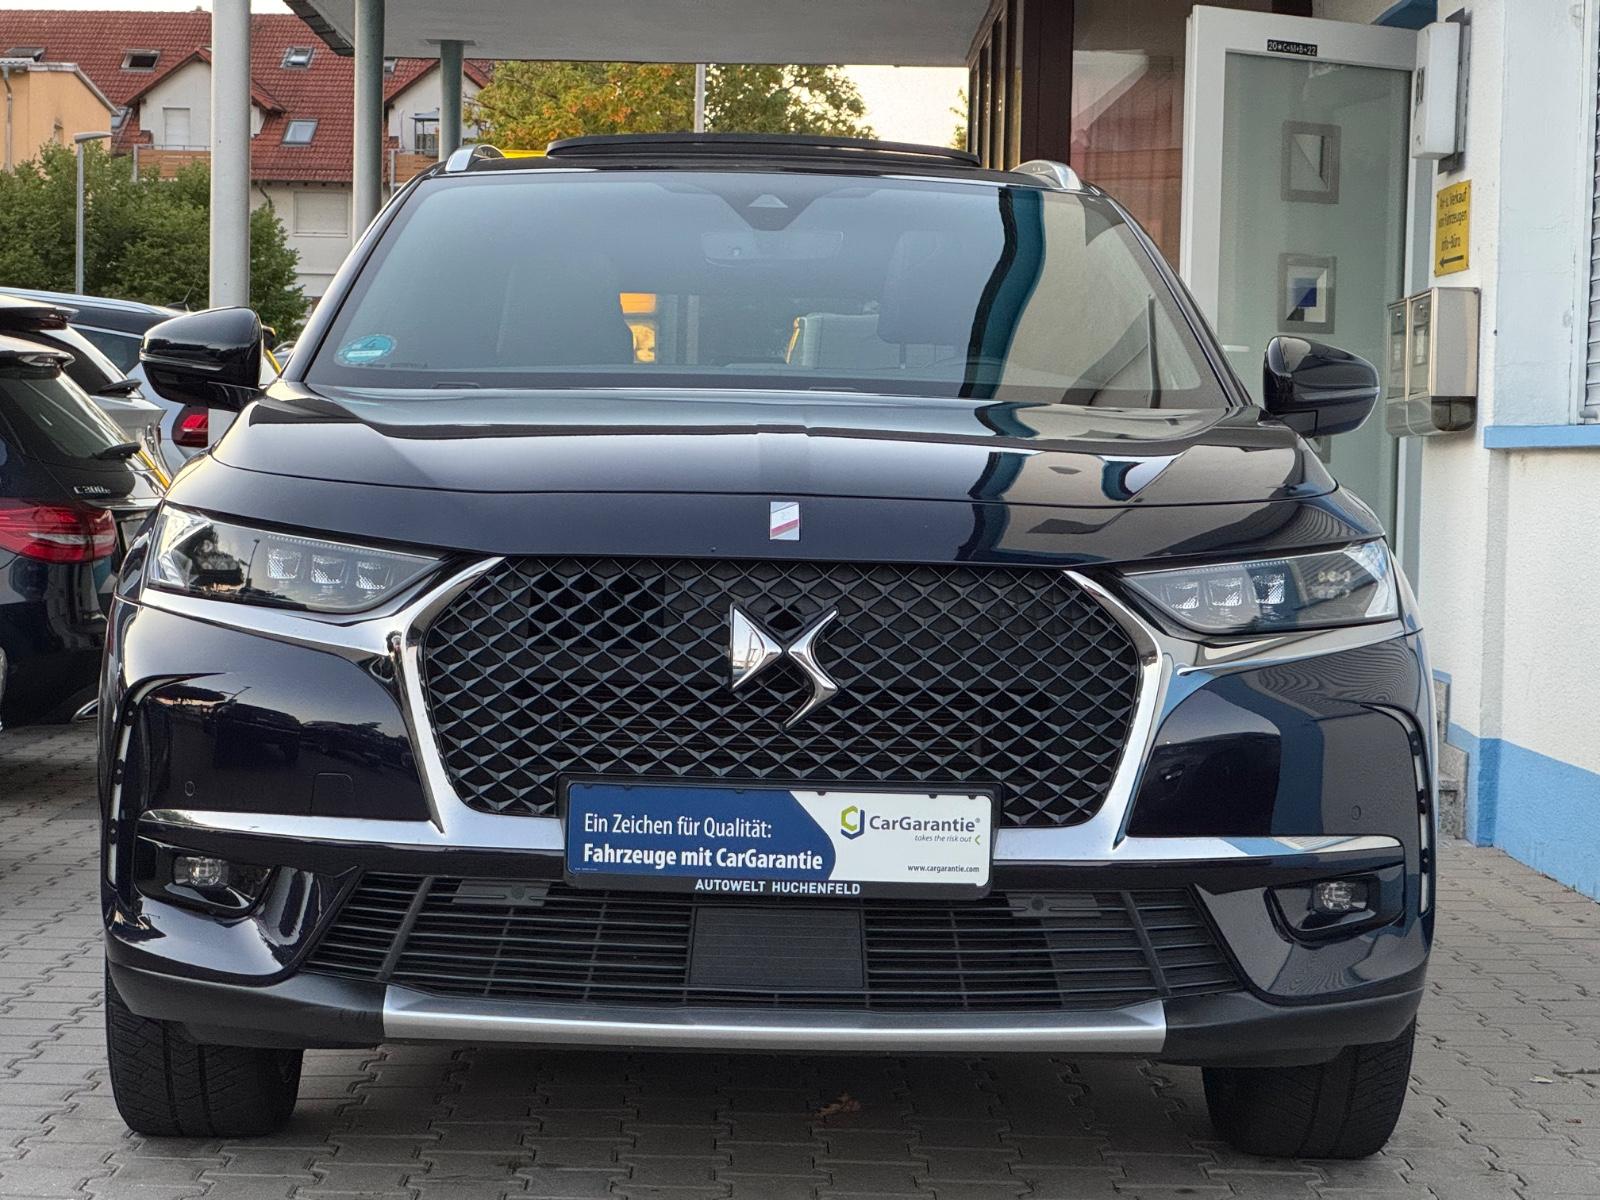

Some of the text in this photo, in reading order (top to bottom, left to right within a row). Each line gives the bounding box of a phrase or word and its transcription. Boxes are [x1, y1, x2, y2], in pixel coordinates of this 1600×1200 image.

[584, 813, 772, 838] Ein Zeichen für Qualität:
[914, 834, 933, 842] takes
[934, 834, 946, 842] the
[959, 835, 972, 843] out
[584, 843, 823, 869] Fahrzeuge mit CarGarantie
[907, 864, 980, 874] www.cargarantie.com
[695, 879, 861, 895] AUTOWELT HUCHENFELD
